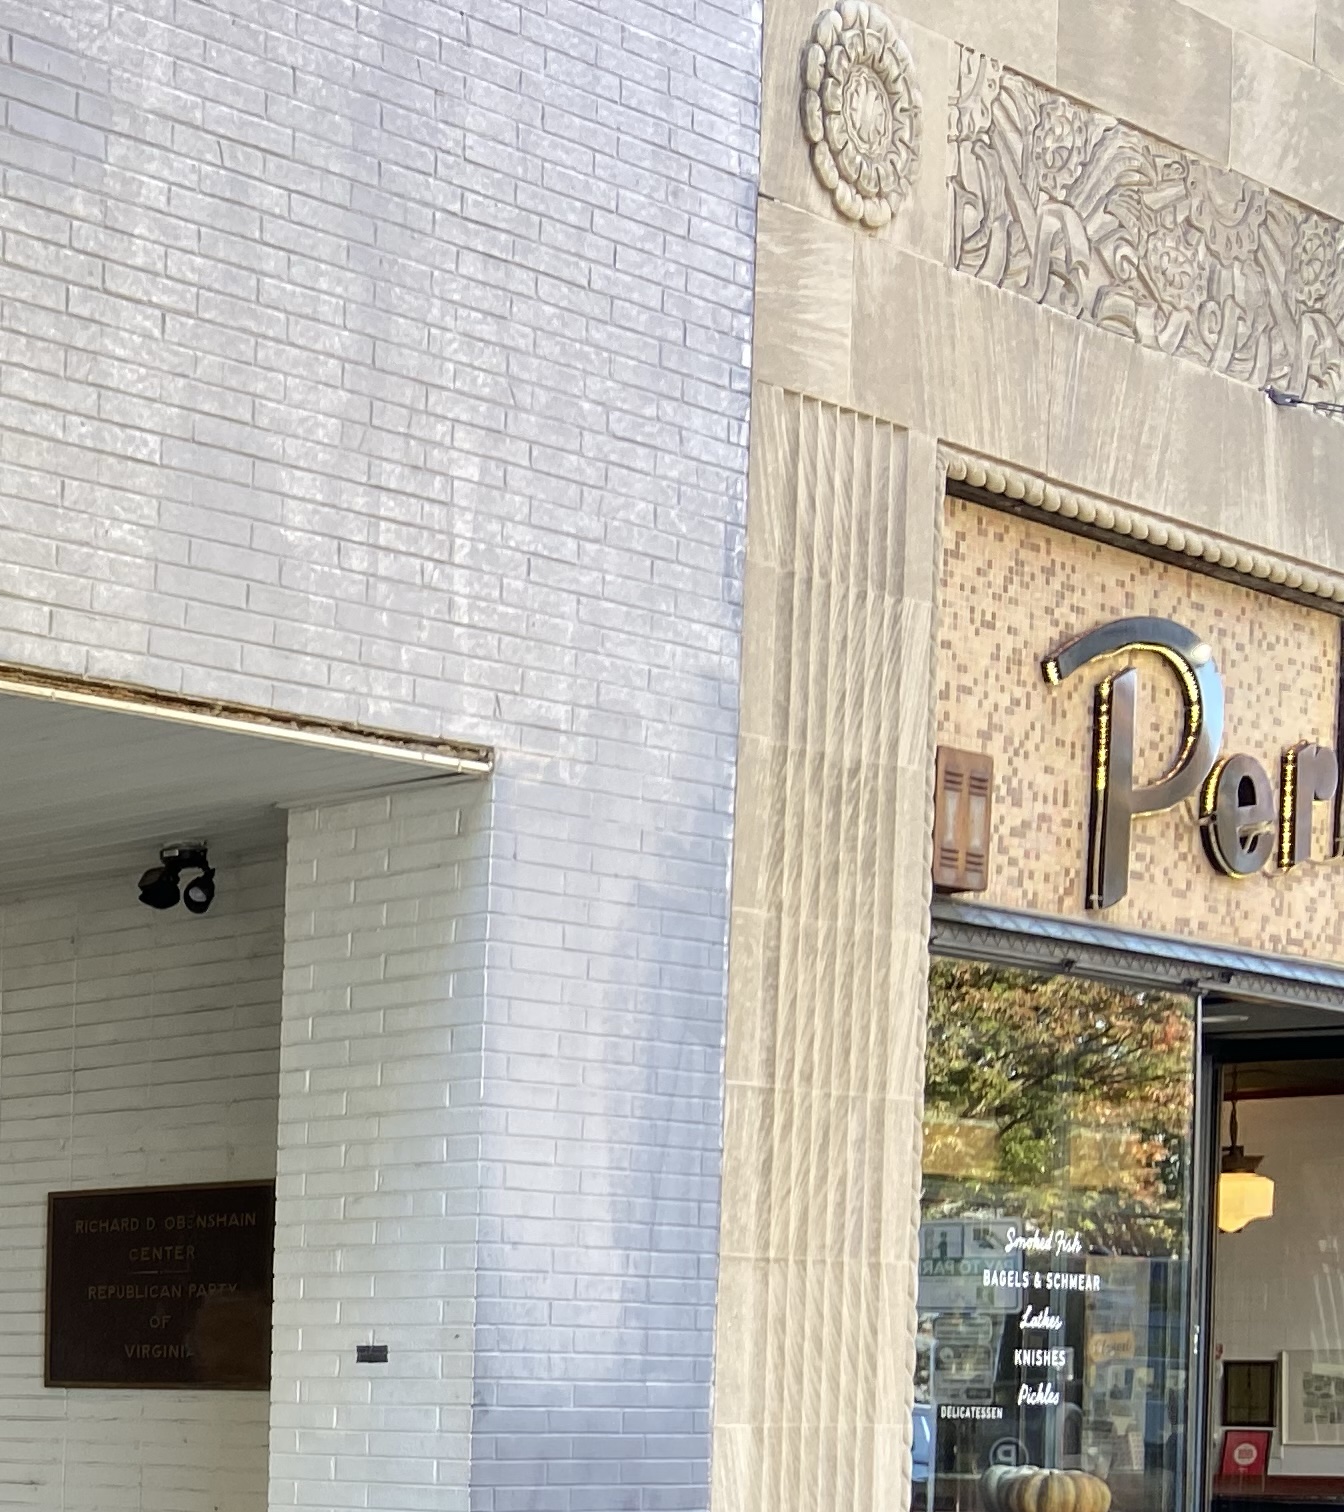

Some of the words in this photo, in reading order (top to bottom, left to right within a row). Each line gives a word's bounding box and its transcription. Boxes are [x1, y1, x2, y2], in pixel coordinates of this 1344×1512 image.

[1041, 616, 1344, 909] Per
[75, 1217, 140, 1234] RICHARD
[164, 1211, 257, 1230] OBENSHAIN
[1005, 1226, 1054, 1253] Smoked
[1055, 1230, 1082, 1257] Fish
[128, 1245, 195, 1261] CENTER
[983, 1269, 1029, 1289] BAGELS
[1033, 1272, 1042, 1289] &
[1046, 1272, 1101, 1291] SCHMEAR
[88, 1285, 182, 1300] REPUBLICAN
[149, 1314, 172, 1329] OF
[1014, 1349, 1066, 1367] KNISHES
[1017, 1382, 1060, 1406] Pickles
[940, 1405, 1003, 1419] DELICATESSEN
